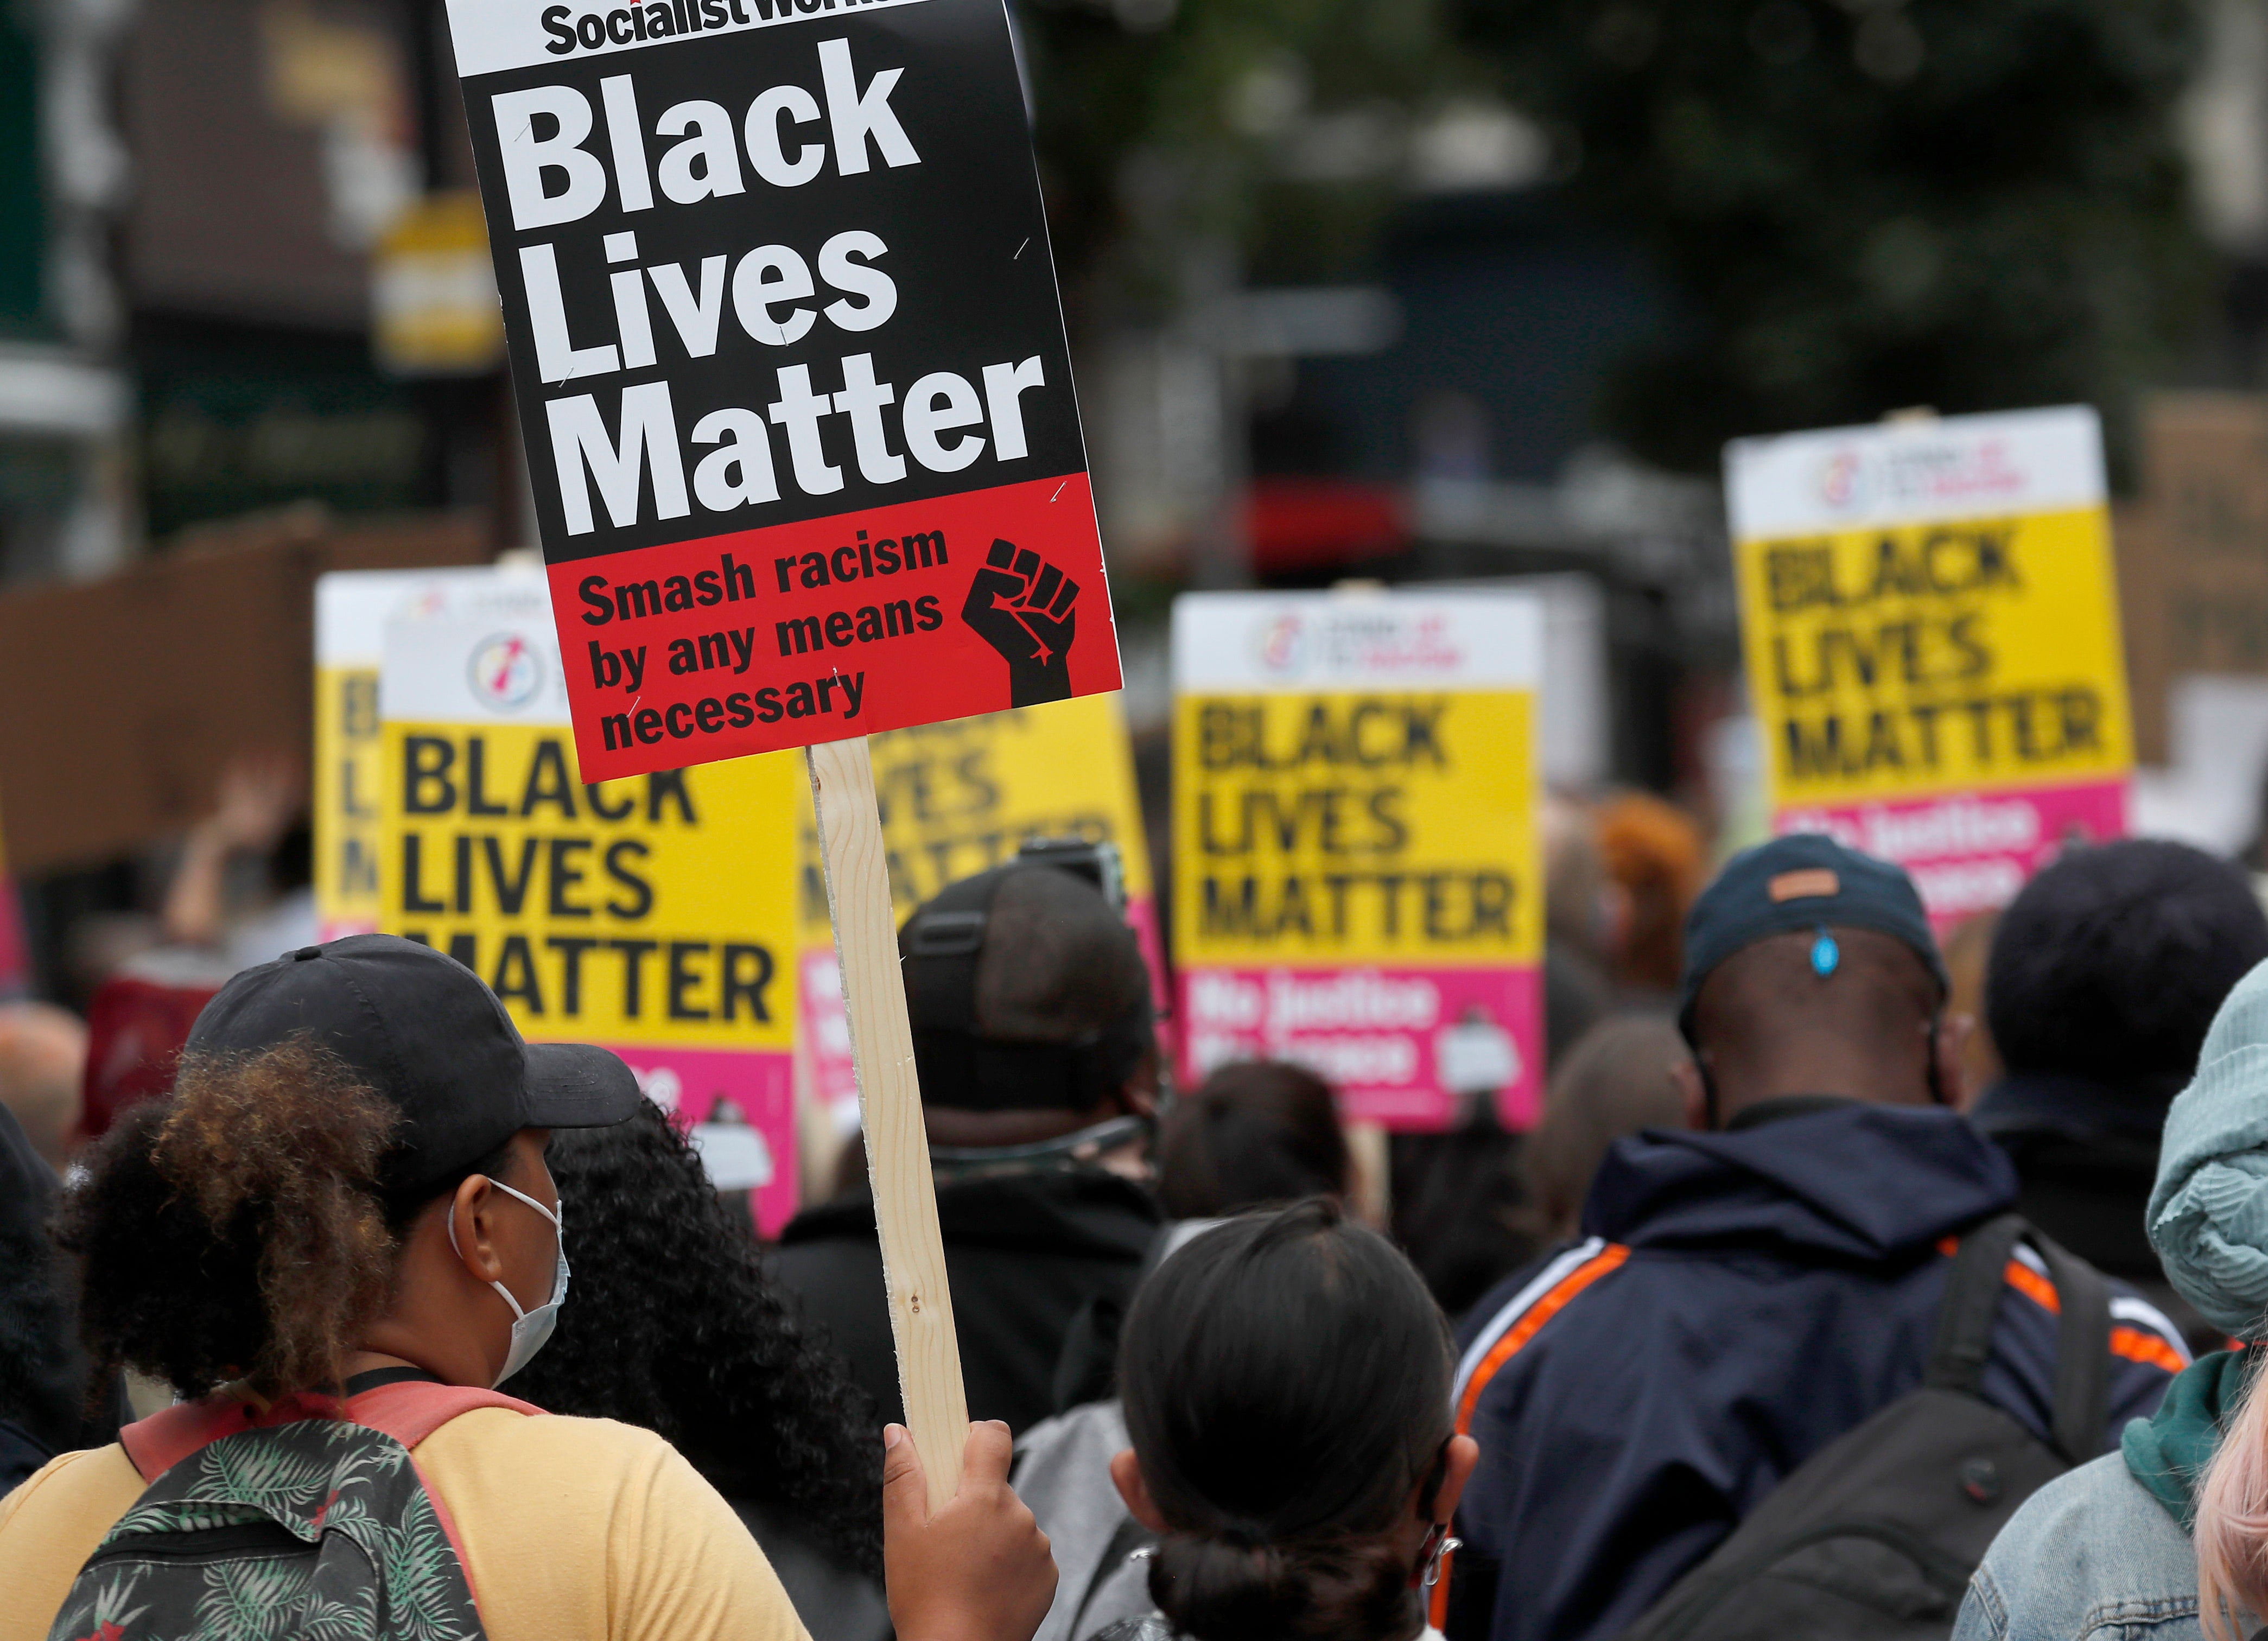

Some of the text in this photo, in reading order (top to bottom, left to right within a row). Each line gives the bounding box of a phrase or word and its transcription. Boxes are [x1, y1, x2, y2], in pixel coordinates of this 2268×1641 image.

[541, 0, 752, 55] Socialist
[491, 37, 922, 232] Black
[518, 230, 898, 387] Lives
[544, 352, 1046, 537] Matter
[578, 552, 756, 626] Smash
[774, 529, 949, 594] racism
[1768, 525, 2022, 612] BLACK
[587, 595, 943, 694] by any means
[1773, 613, 1996, 700] LIVES
[600, 671, 865, 752] necessary
[1202, 699, 1449, 775] BLACK
[1784, 687, 2101, 780] MATTER
[1201, 787, 1412, 855] LIVES
[402, 834, 655, 918] LIVES
[1201, 869, 1515, 942] MATTER
